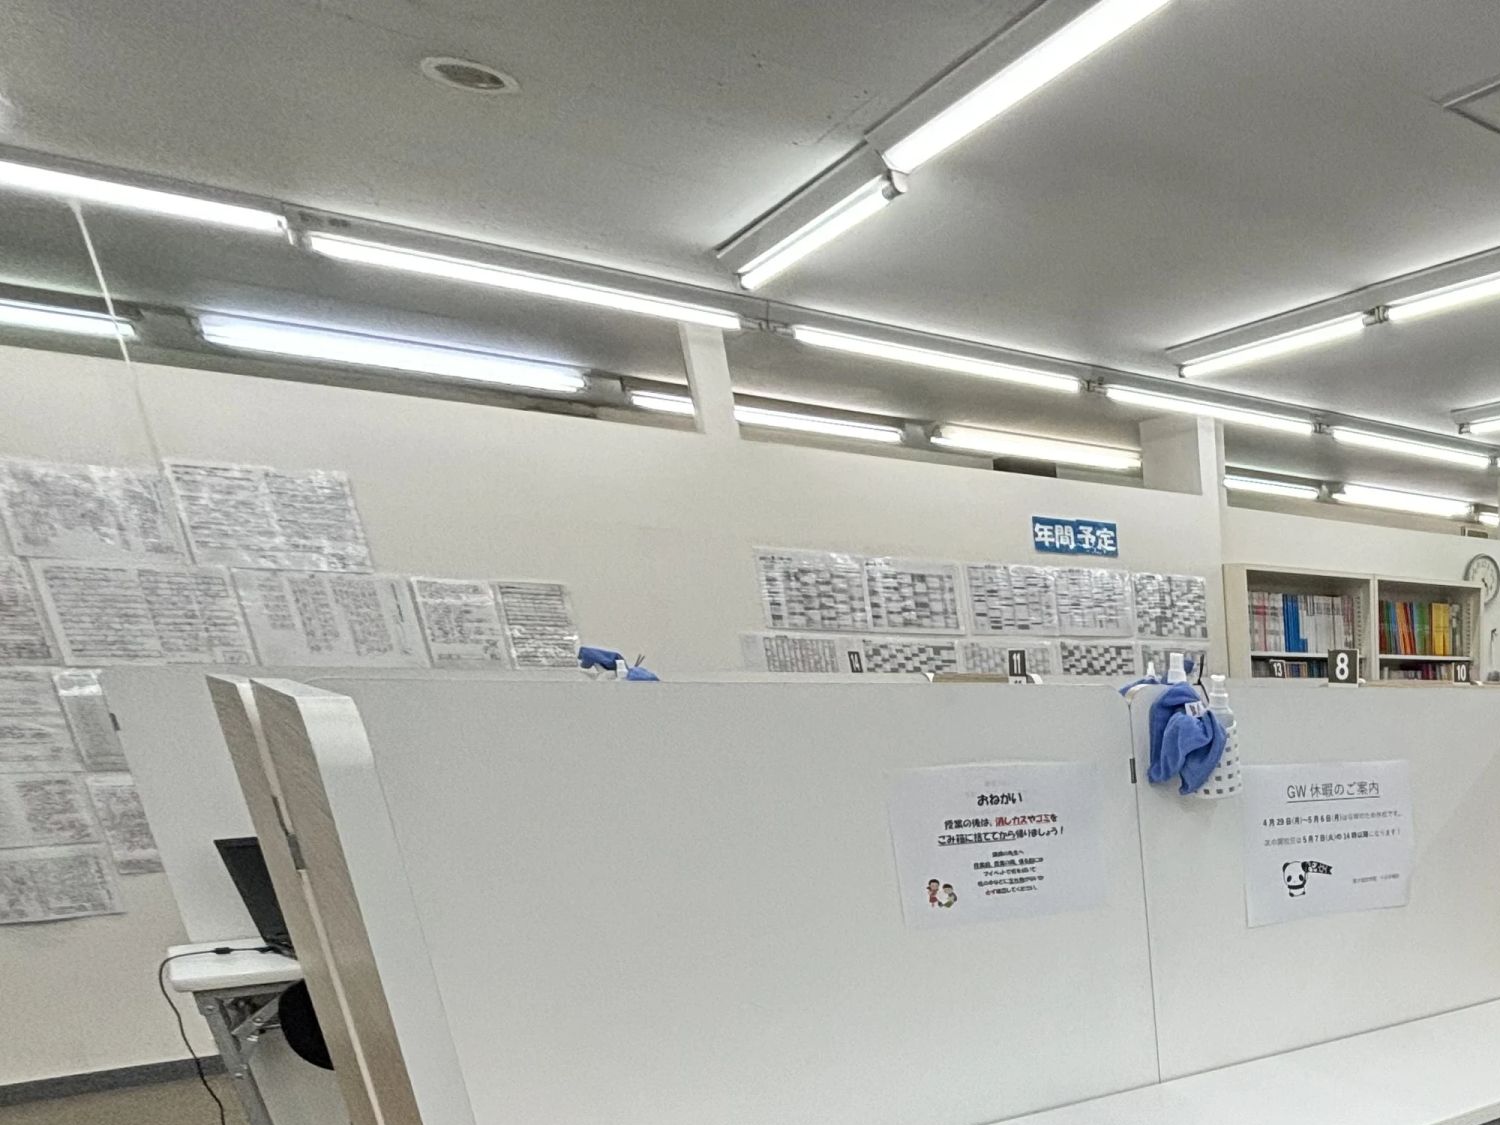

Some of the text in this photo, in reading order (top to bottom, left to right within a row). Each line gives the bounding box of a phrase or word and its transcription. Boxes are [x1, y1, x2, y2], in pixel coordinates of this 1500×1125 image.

[1034, 522, 1117, 551] 年間予定
[1012, 653, 1020, 674] 11
[1273, 662, 1283, 677] 13
[1335, 652, 1349, 680] 8
[1456, 664, 1466, 682] 10
[1286, 780, 1380, 799] GW 休暇のご案内
[977, 793, 1023, 806] おねがい
